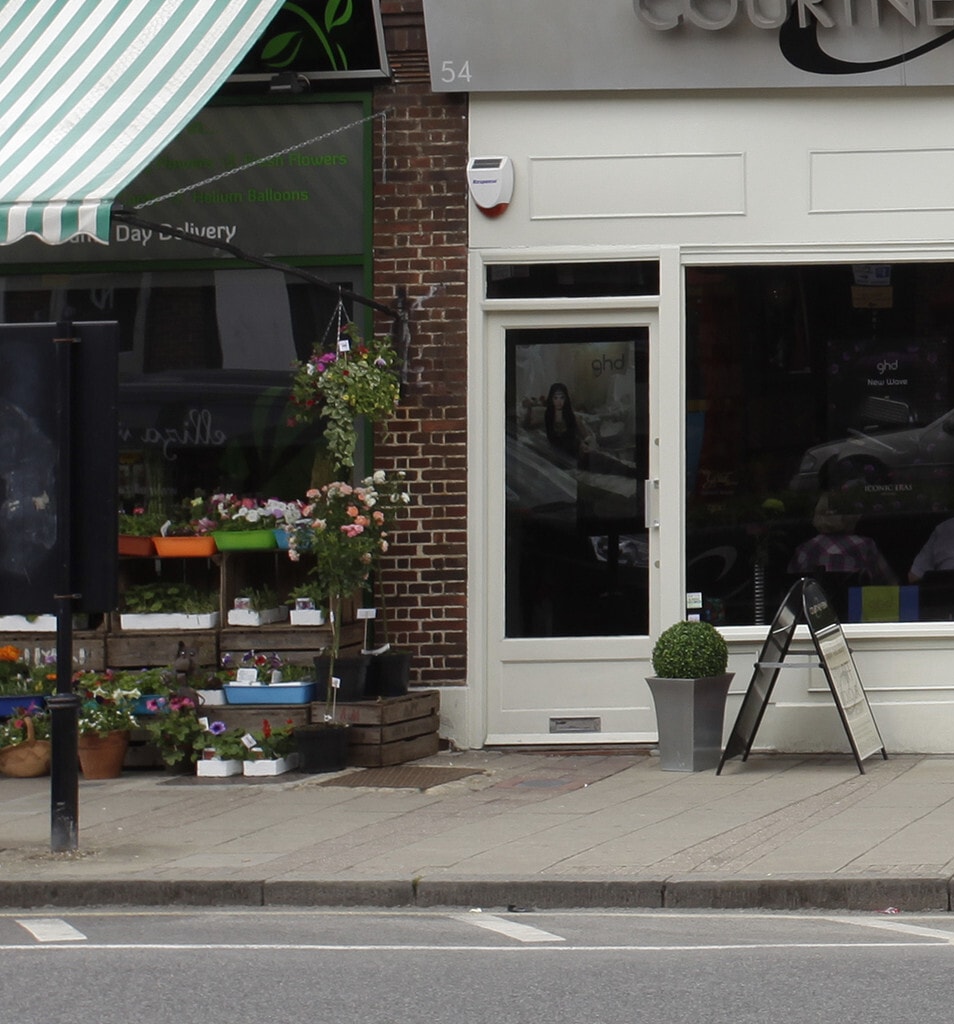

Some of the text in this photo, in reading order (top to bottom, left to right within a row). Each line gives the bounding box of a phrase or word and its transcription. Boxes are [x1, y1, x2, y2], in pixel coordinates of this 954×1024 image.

[441, 60, 472, 83] 54
[288, 152, 348, 166] Flowers
[192, 189, 242, 204] Helium
[247, 187, 309, 203] Balloons
[116, 224, 152, 246] Day
[591, 353, 626, 377] ghd
[877, 359, 899, 375] ghd
[867, 377, 908, 386] New Wave
